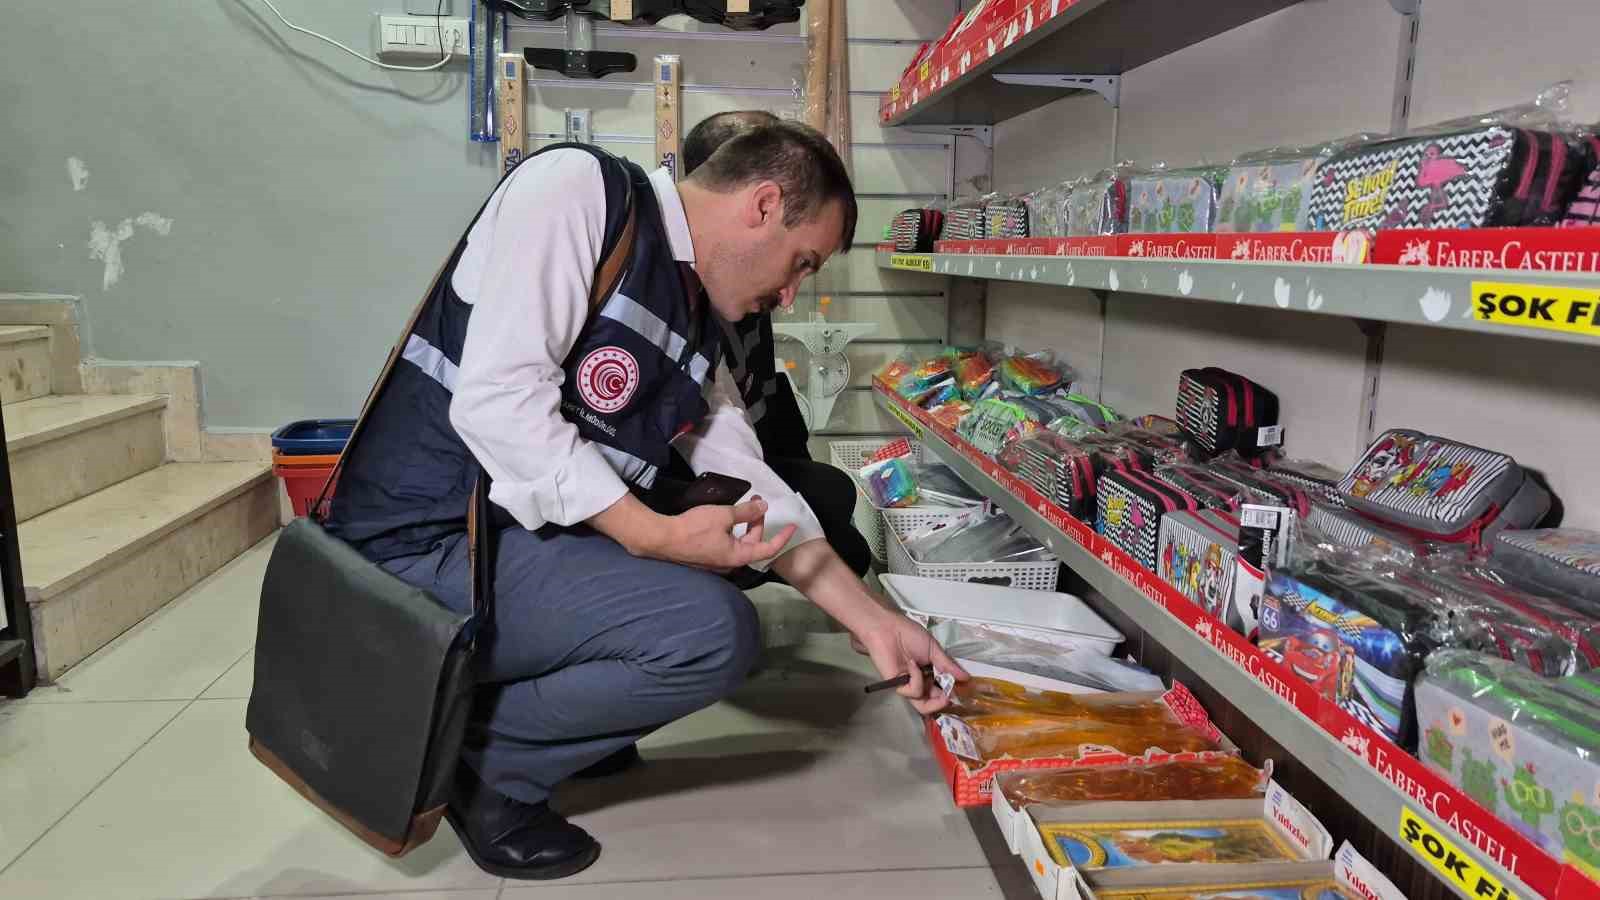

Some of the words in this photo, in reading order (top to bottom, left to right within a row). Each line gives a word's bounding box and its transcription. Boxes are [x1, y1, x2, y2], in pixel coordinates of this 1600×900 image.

[1253, 239, 1333, 263] FABER-CASTE
[1436, 241, 1599, 272] FABER-CASTELL
[1478, 292, 1557, 320] ŞOK
[1263, 606, 1278, 630] 66
[1215, 628, 1297, 706] FABER-CASTELL
[1374, 747, 1519, 876] FABER-CASTELL
[1403, 818, 1471, 883] ŞOK
